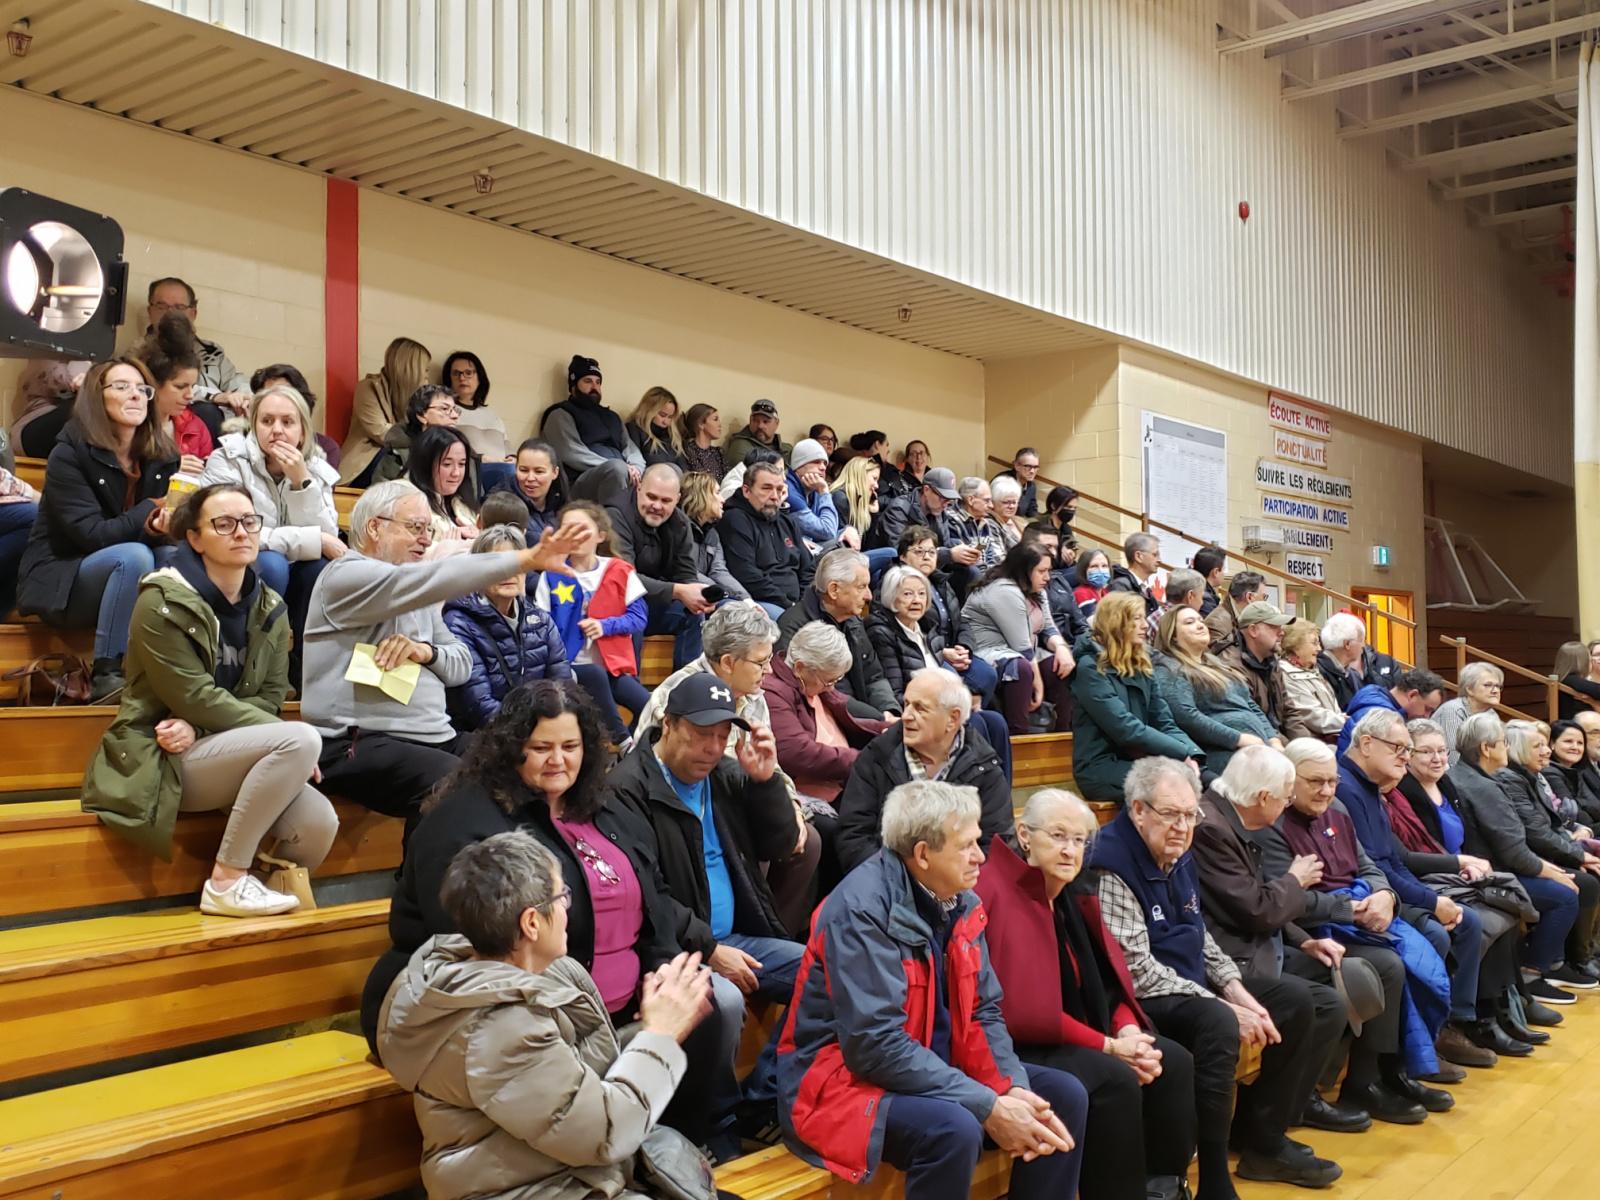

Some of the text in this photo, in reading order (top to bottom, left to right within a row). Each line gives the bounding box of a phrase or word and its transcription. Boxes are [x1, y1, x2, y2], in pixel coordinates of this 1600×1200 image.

[1270, 402, 1330, 434] ÉCOUTE ACTIVE
[1276, 438, 1327, 463] PONCTUALITÉ
[1257, 467, 1285, 486] SUIVRE
[1289, 474, 1304, 489] LES
[1263, 498, 1348, 525] PARTICIPATION ACTIVE
